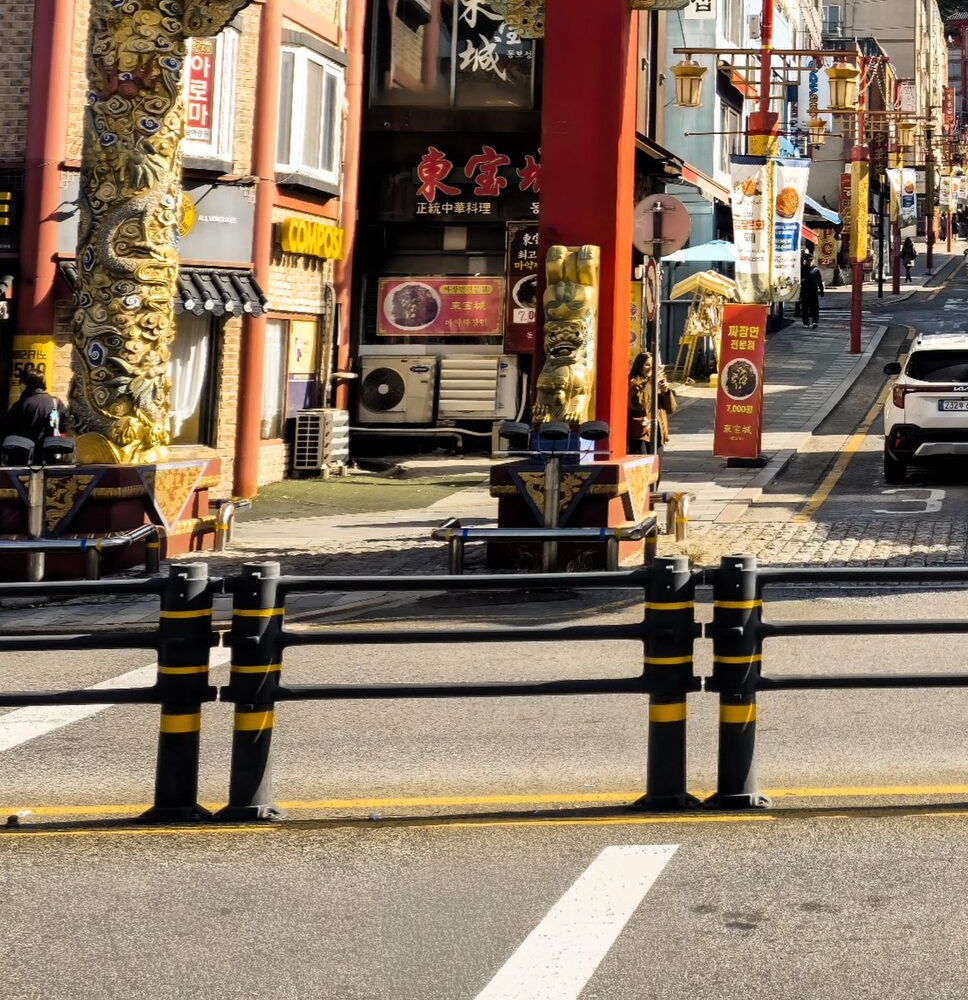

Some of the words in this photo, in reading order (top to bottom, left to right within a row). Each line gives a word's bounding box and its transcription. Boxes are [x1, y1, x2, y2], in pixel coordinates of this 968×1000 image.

[506, 50, 532, 59] 동보성
[189, 56, 211, 125] 아로마
[416, 202, 491, 214] 正統中華料理
[518, 250, 537, 261] 최고
[514, 261, 538, 271] 마약
[728, 325, 760, 339] 짜장면
[730, 339, 755, 351] 전문점
